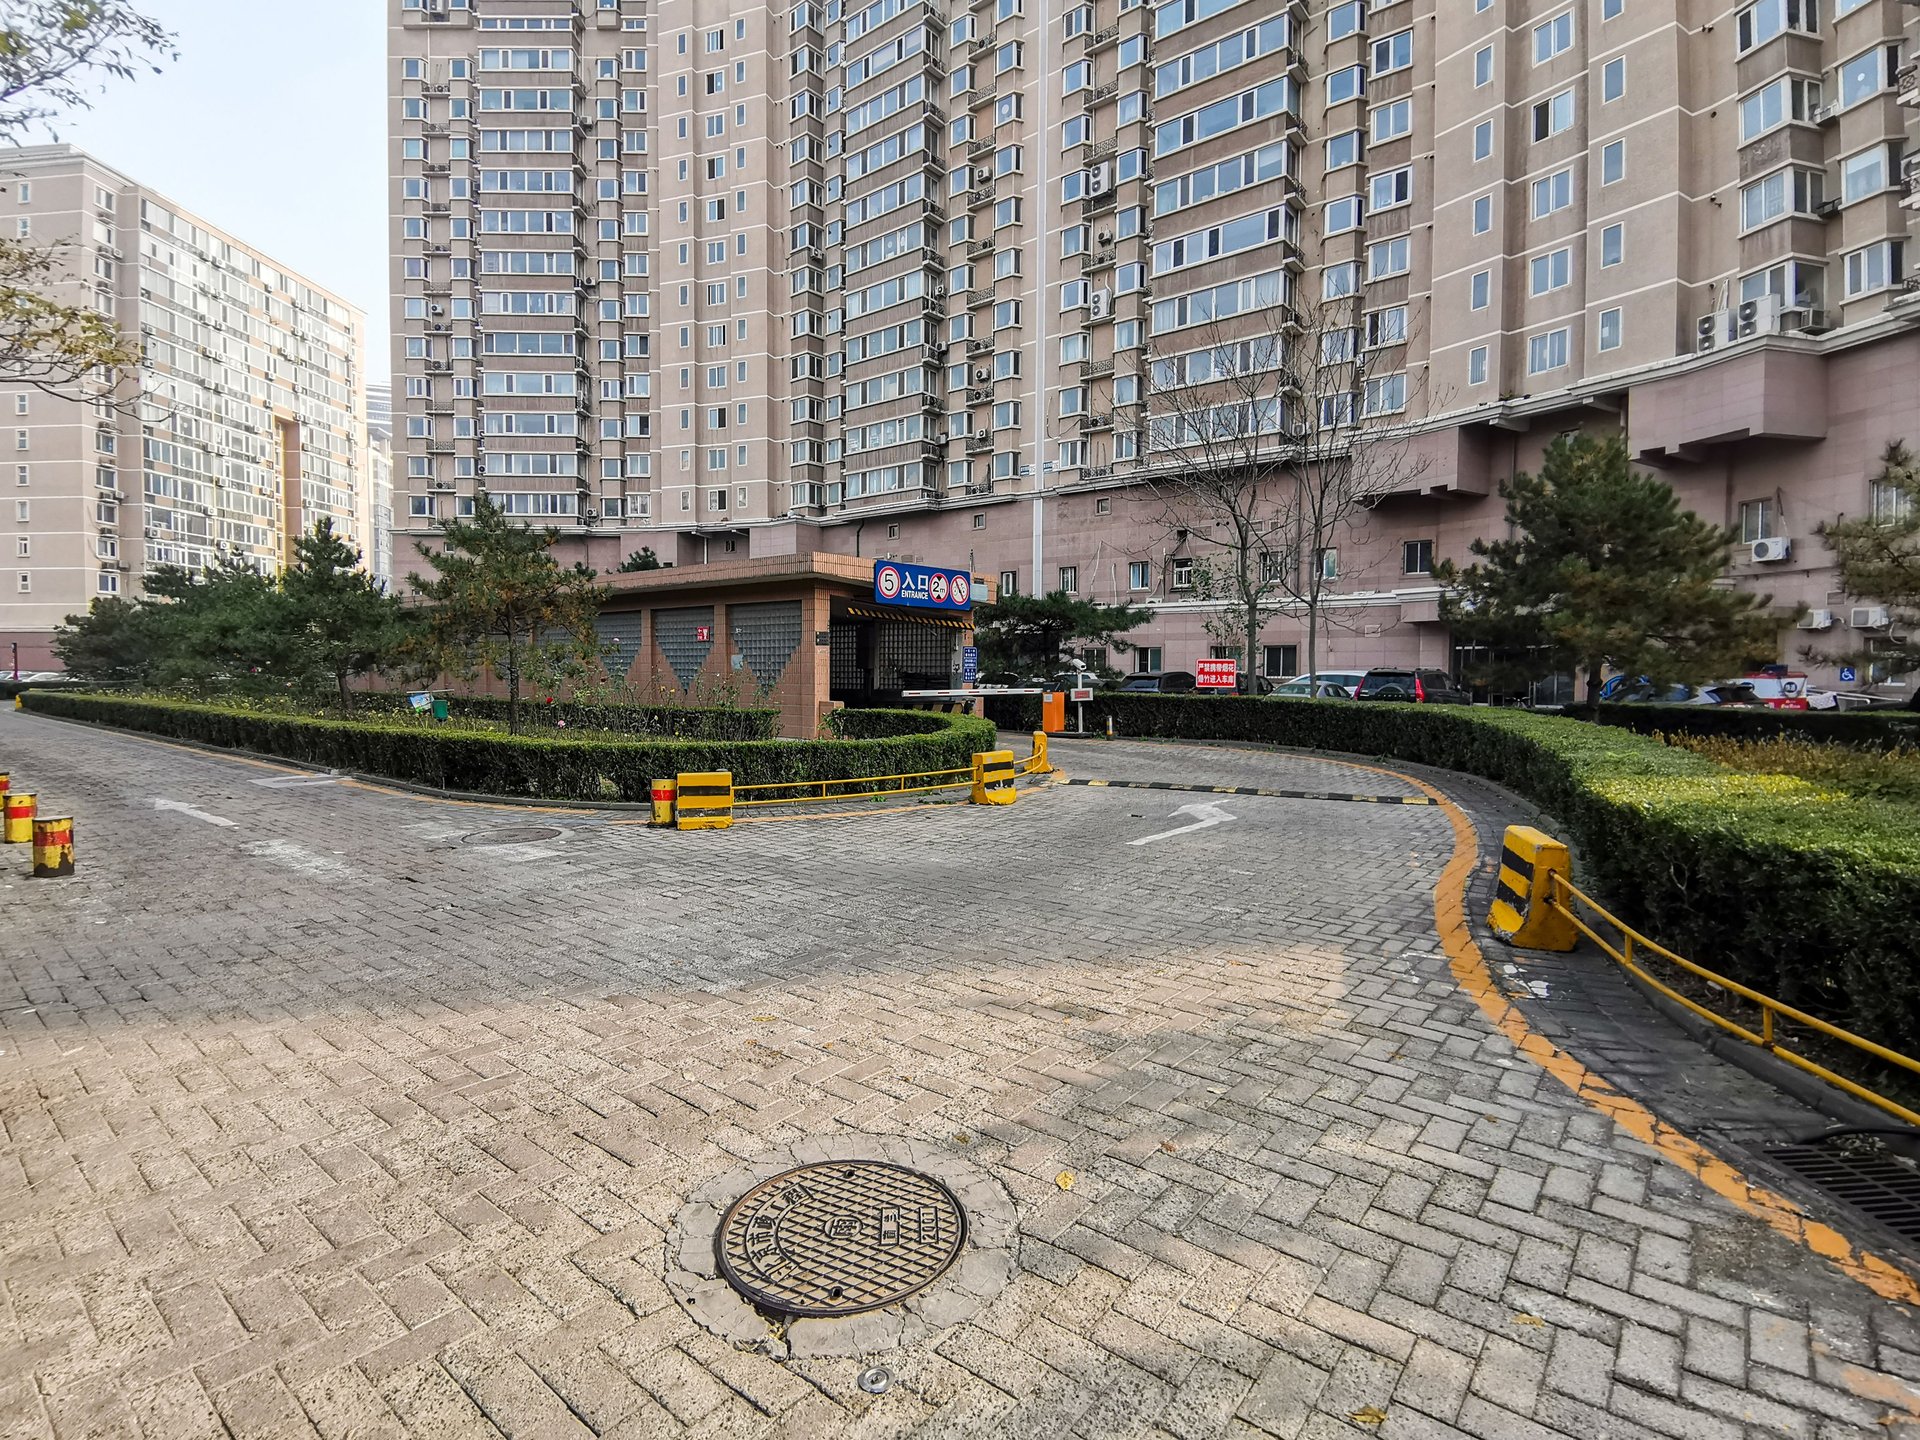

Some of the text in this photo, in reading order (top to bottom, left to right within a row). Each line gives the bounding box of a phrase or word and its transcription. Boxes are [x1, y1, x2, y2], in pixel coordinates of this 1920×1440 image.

[884, 573, 894, 592] 5
[901, 571, 929, 590] 入口
[901, 589, 929, 600] ENTRANCE
[1198, 674, 1234, 683] 爆竹进入车库
[830, 1218, 860, 1238] 雨
[921, 1209, 938, 1242] 2001
